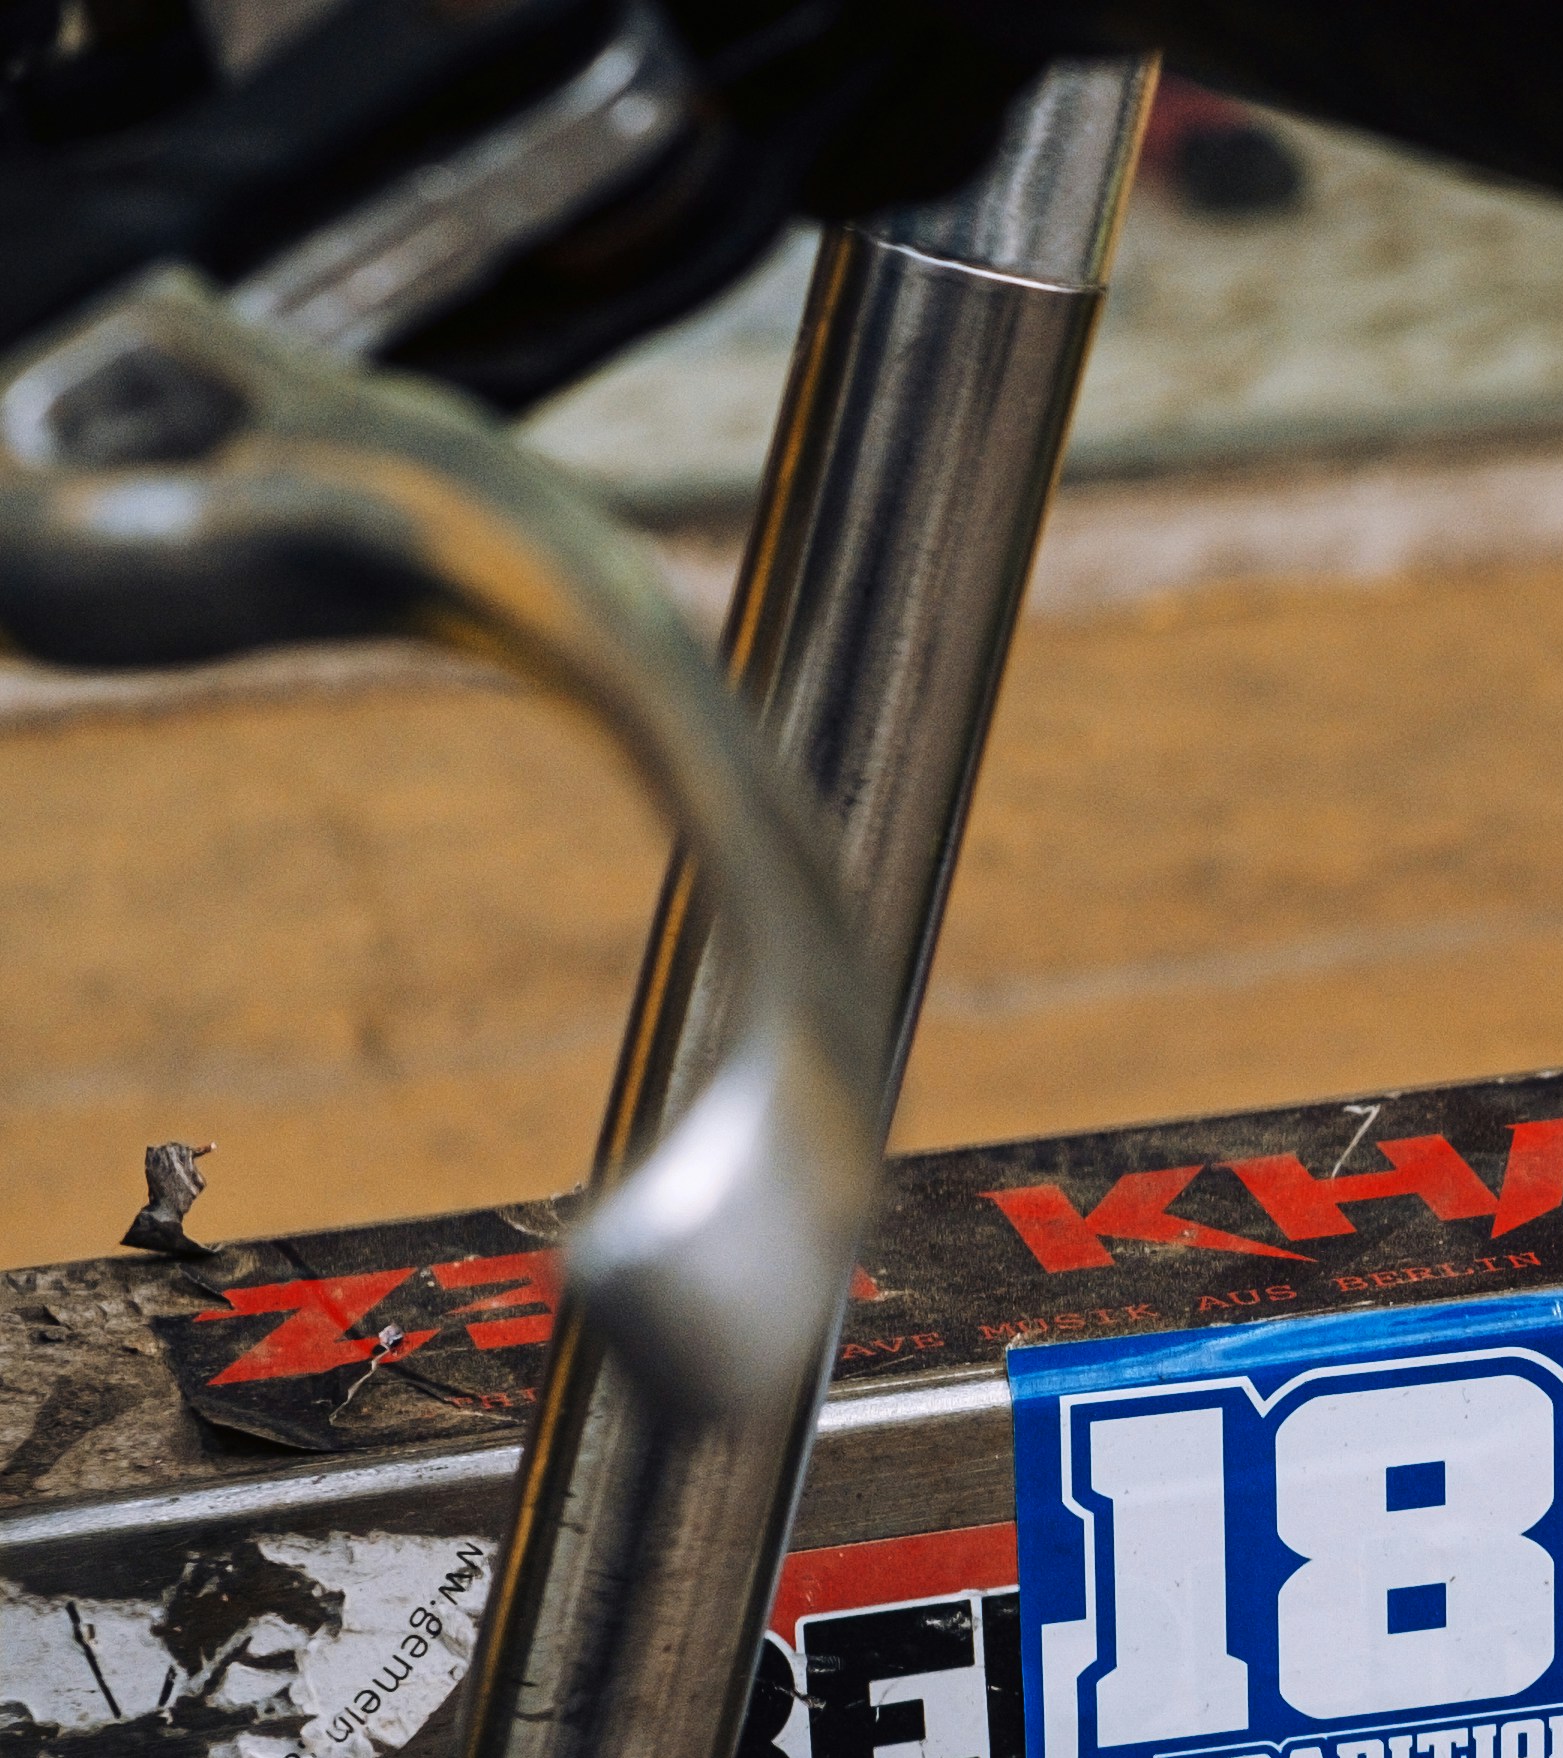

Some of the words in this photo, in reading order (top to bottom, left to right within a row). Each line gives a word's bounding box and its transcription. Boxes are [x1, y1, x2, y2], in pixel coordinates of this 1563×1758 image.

[977, 1303, 1158, 1342] MUSIK
[1199, 1284, 1299, 1312] AUS
[1332, 1251, 1543, 1292] BERLIN
